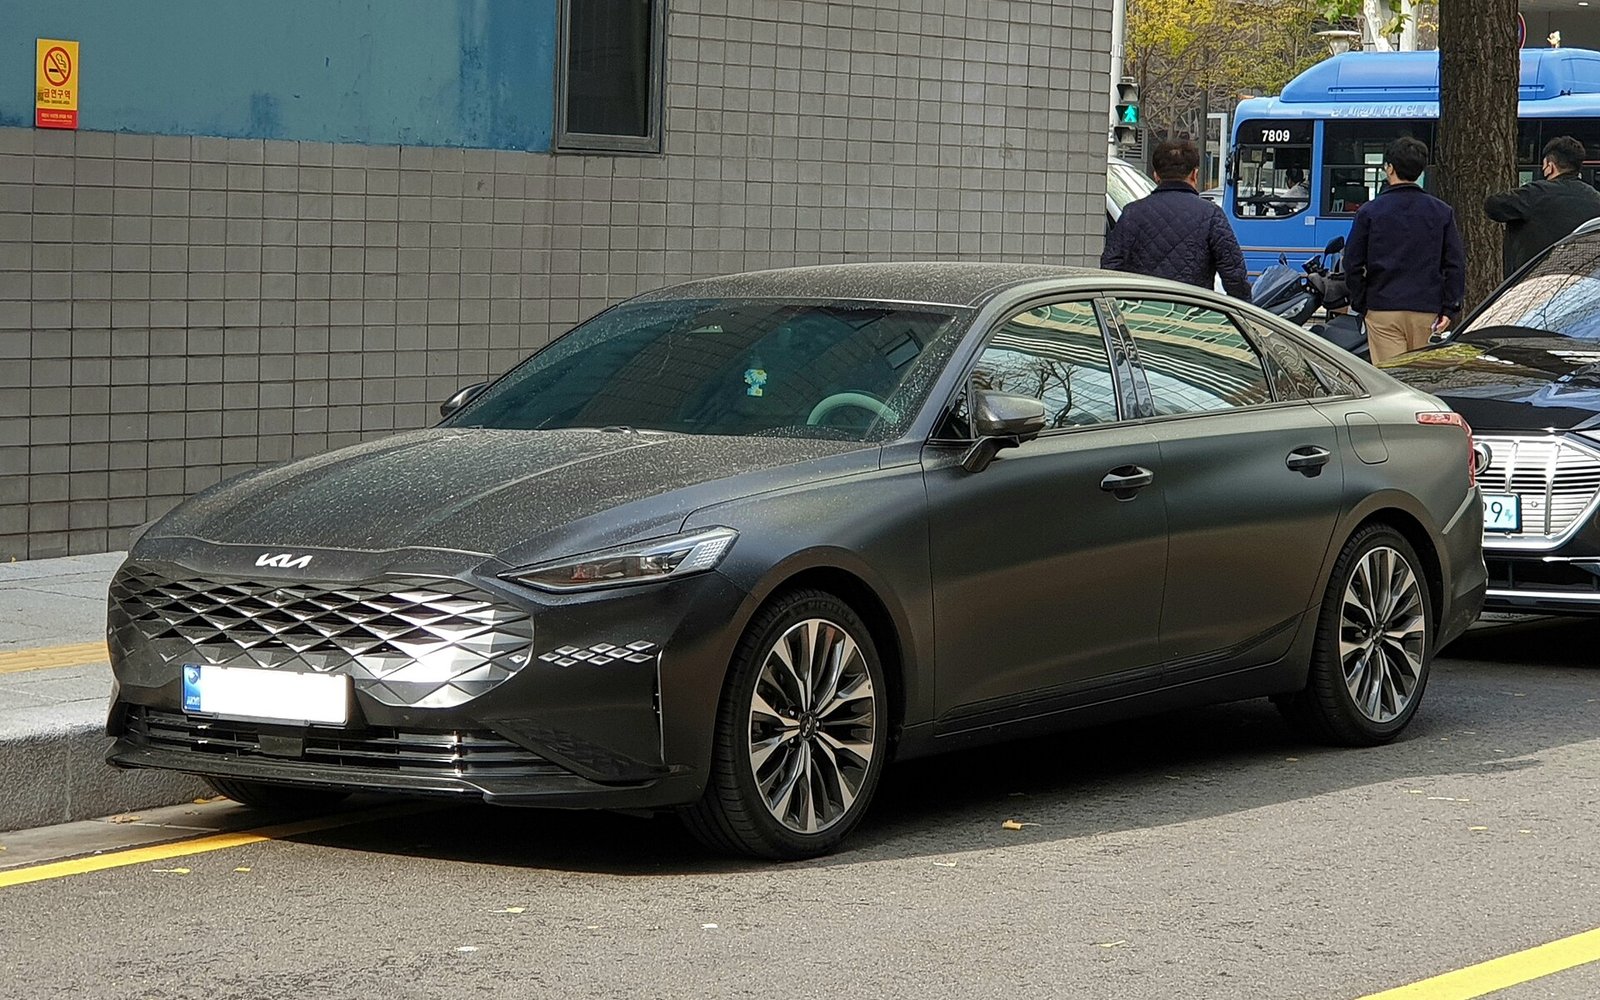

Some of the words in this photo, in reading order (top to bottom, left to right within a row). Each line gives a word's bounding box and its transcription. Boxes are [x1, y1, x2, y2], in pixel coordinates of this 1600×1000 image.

[44, 88, 71, 100] 금연구역
[1262, 129, 1290, 142] 7809
[255, 552, 313, 569] KIA
